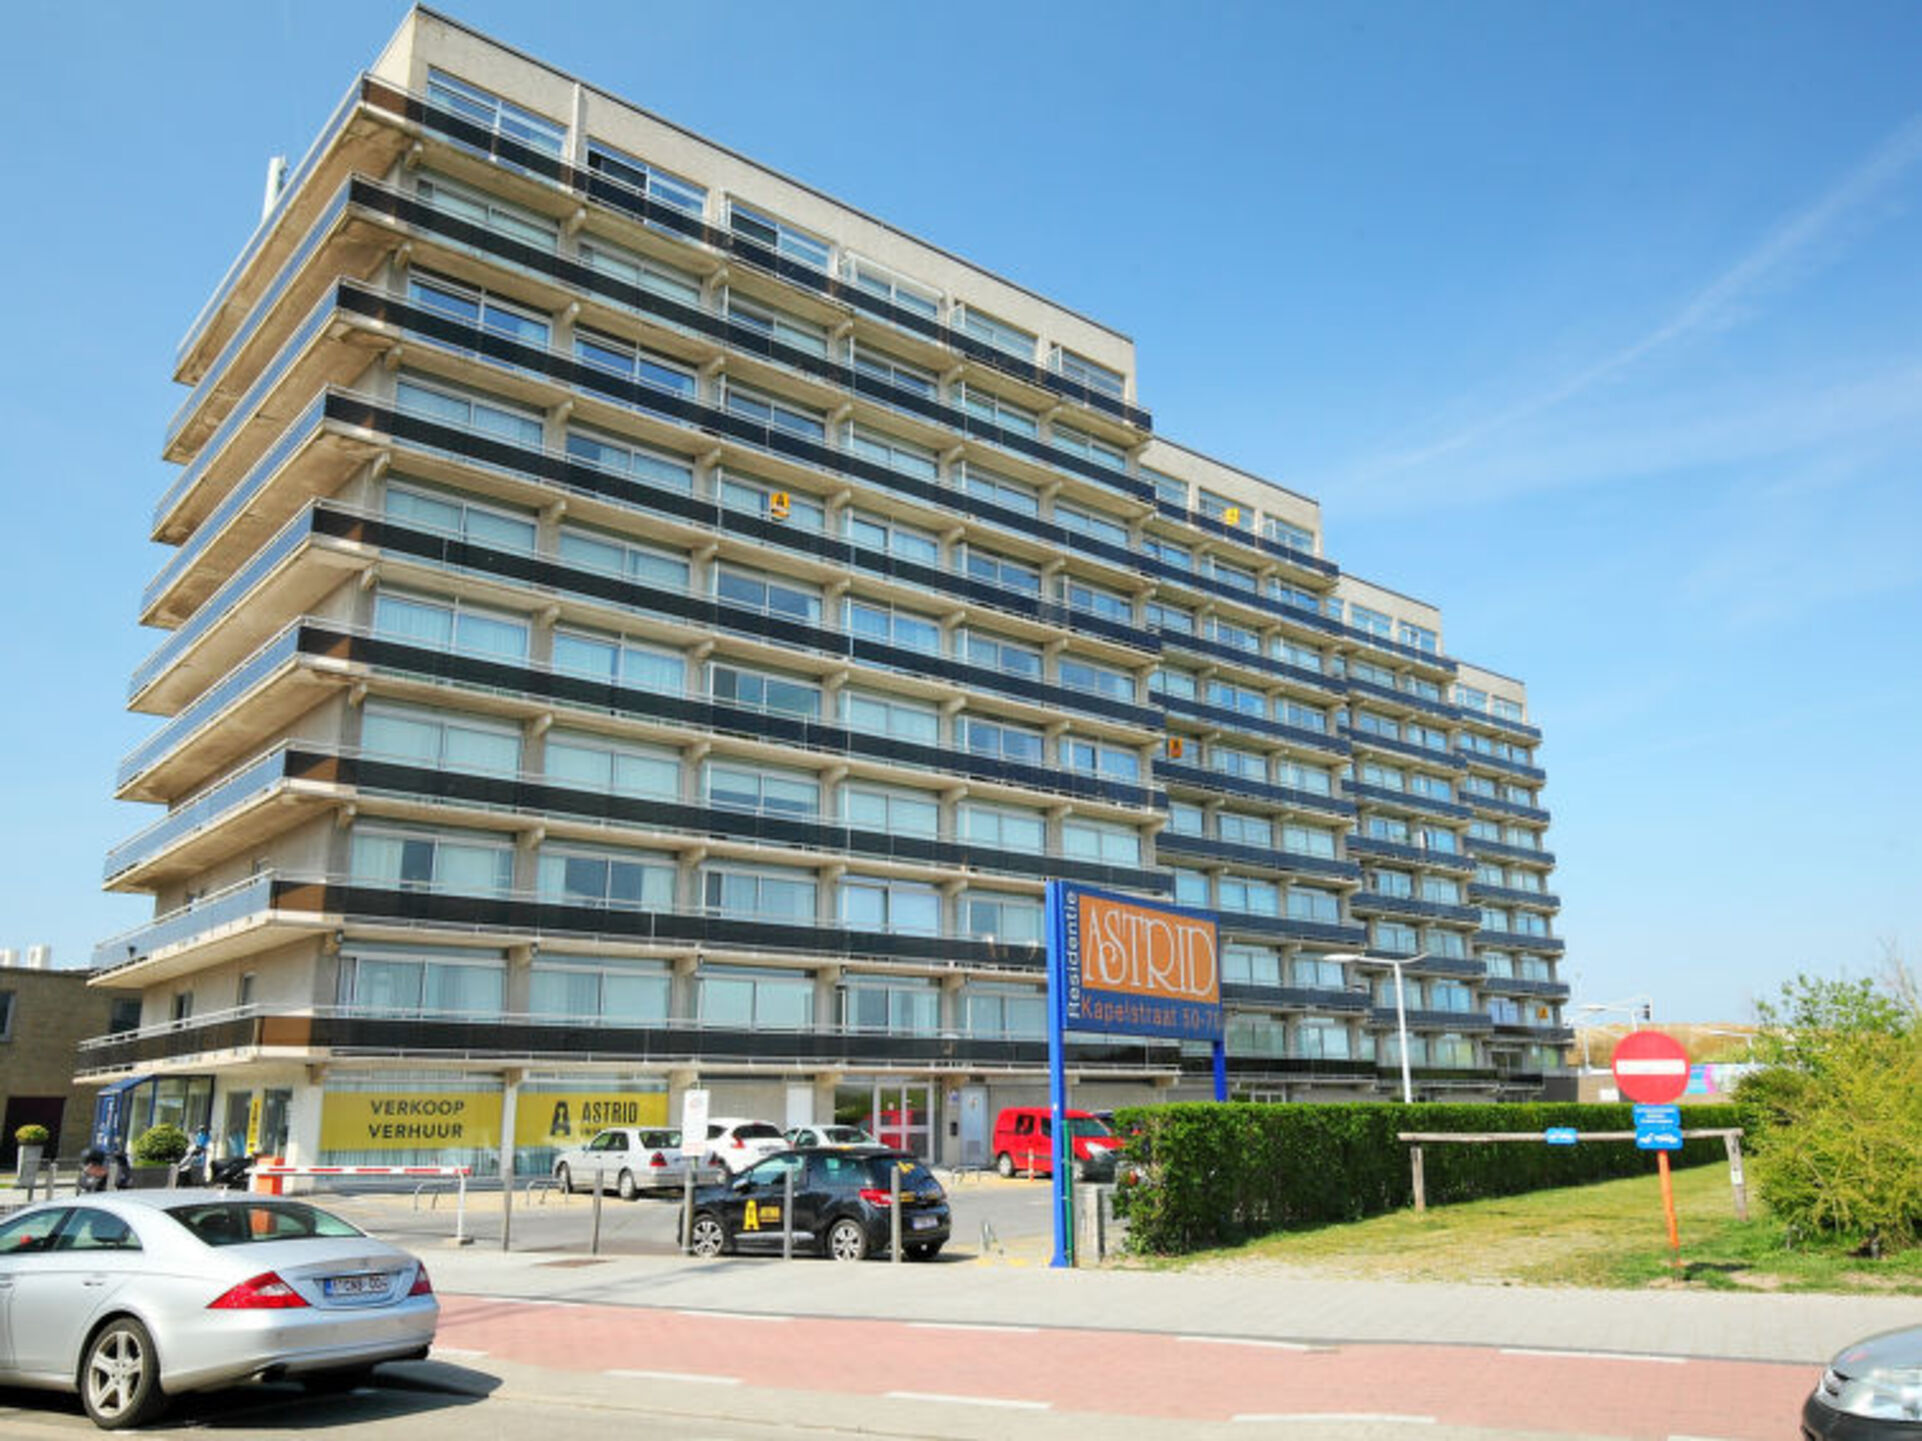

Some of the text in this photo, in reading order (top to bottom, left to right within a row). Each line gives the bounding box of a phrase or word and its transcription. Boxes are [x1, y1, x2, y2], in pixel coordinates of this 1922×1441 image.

[1065, 890, 1080, 1018] Residentie
[1084, 905, 1216, 996] ASTRID
[370, 1100, 464, 1116] VERKOOP
[582, 1101, 638, 1124] ASTRID
[368, 1123, 463, 1138] VERHUUR
